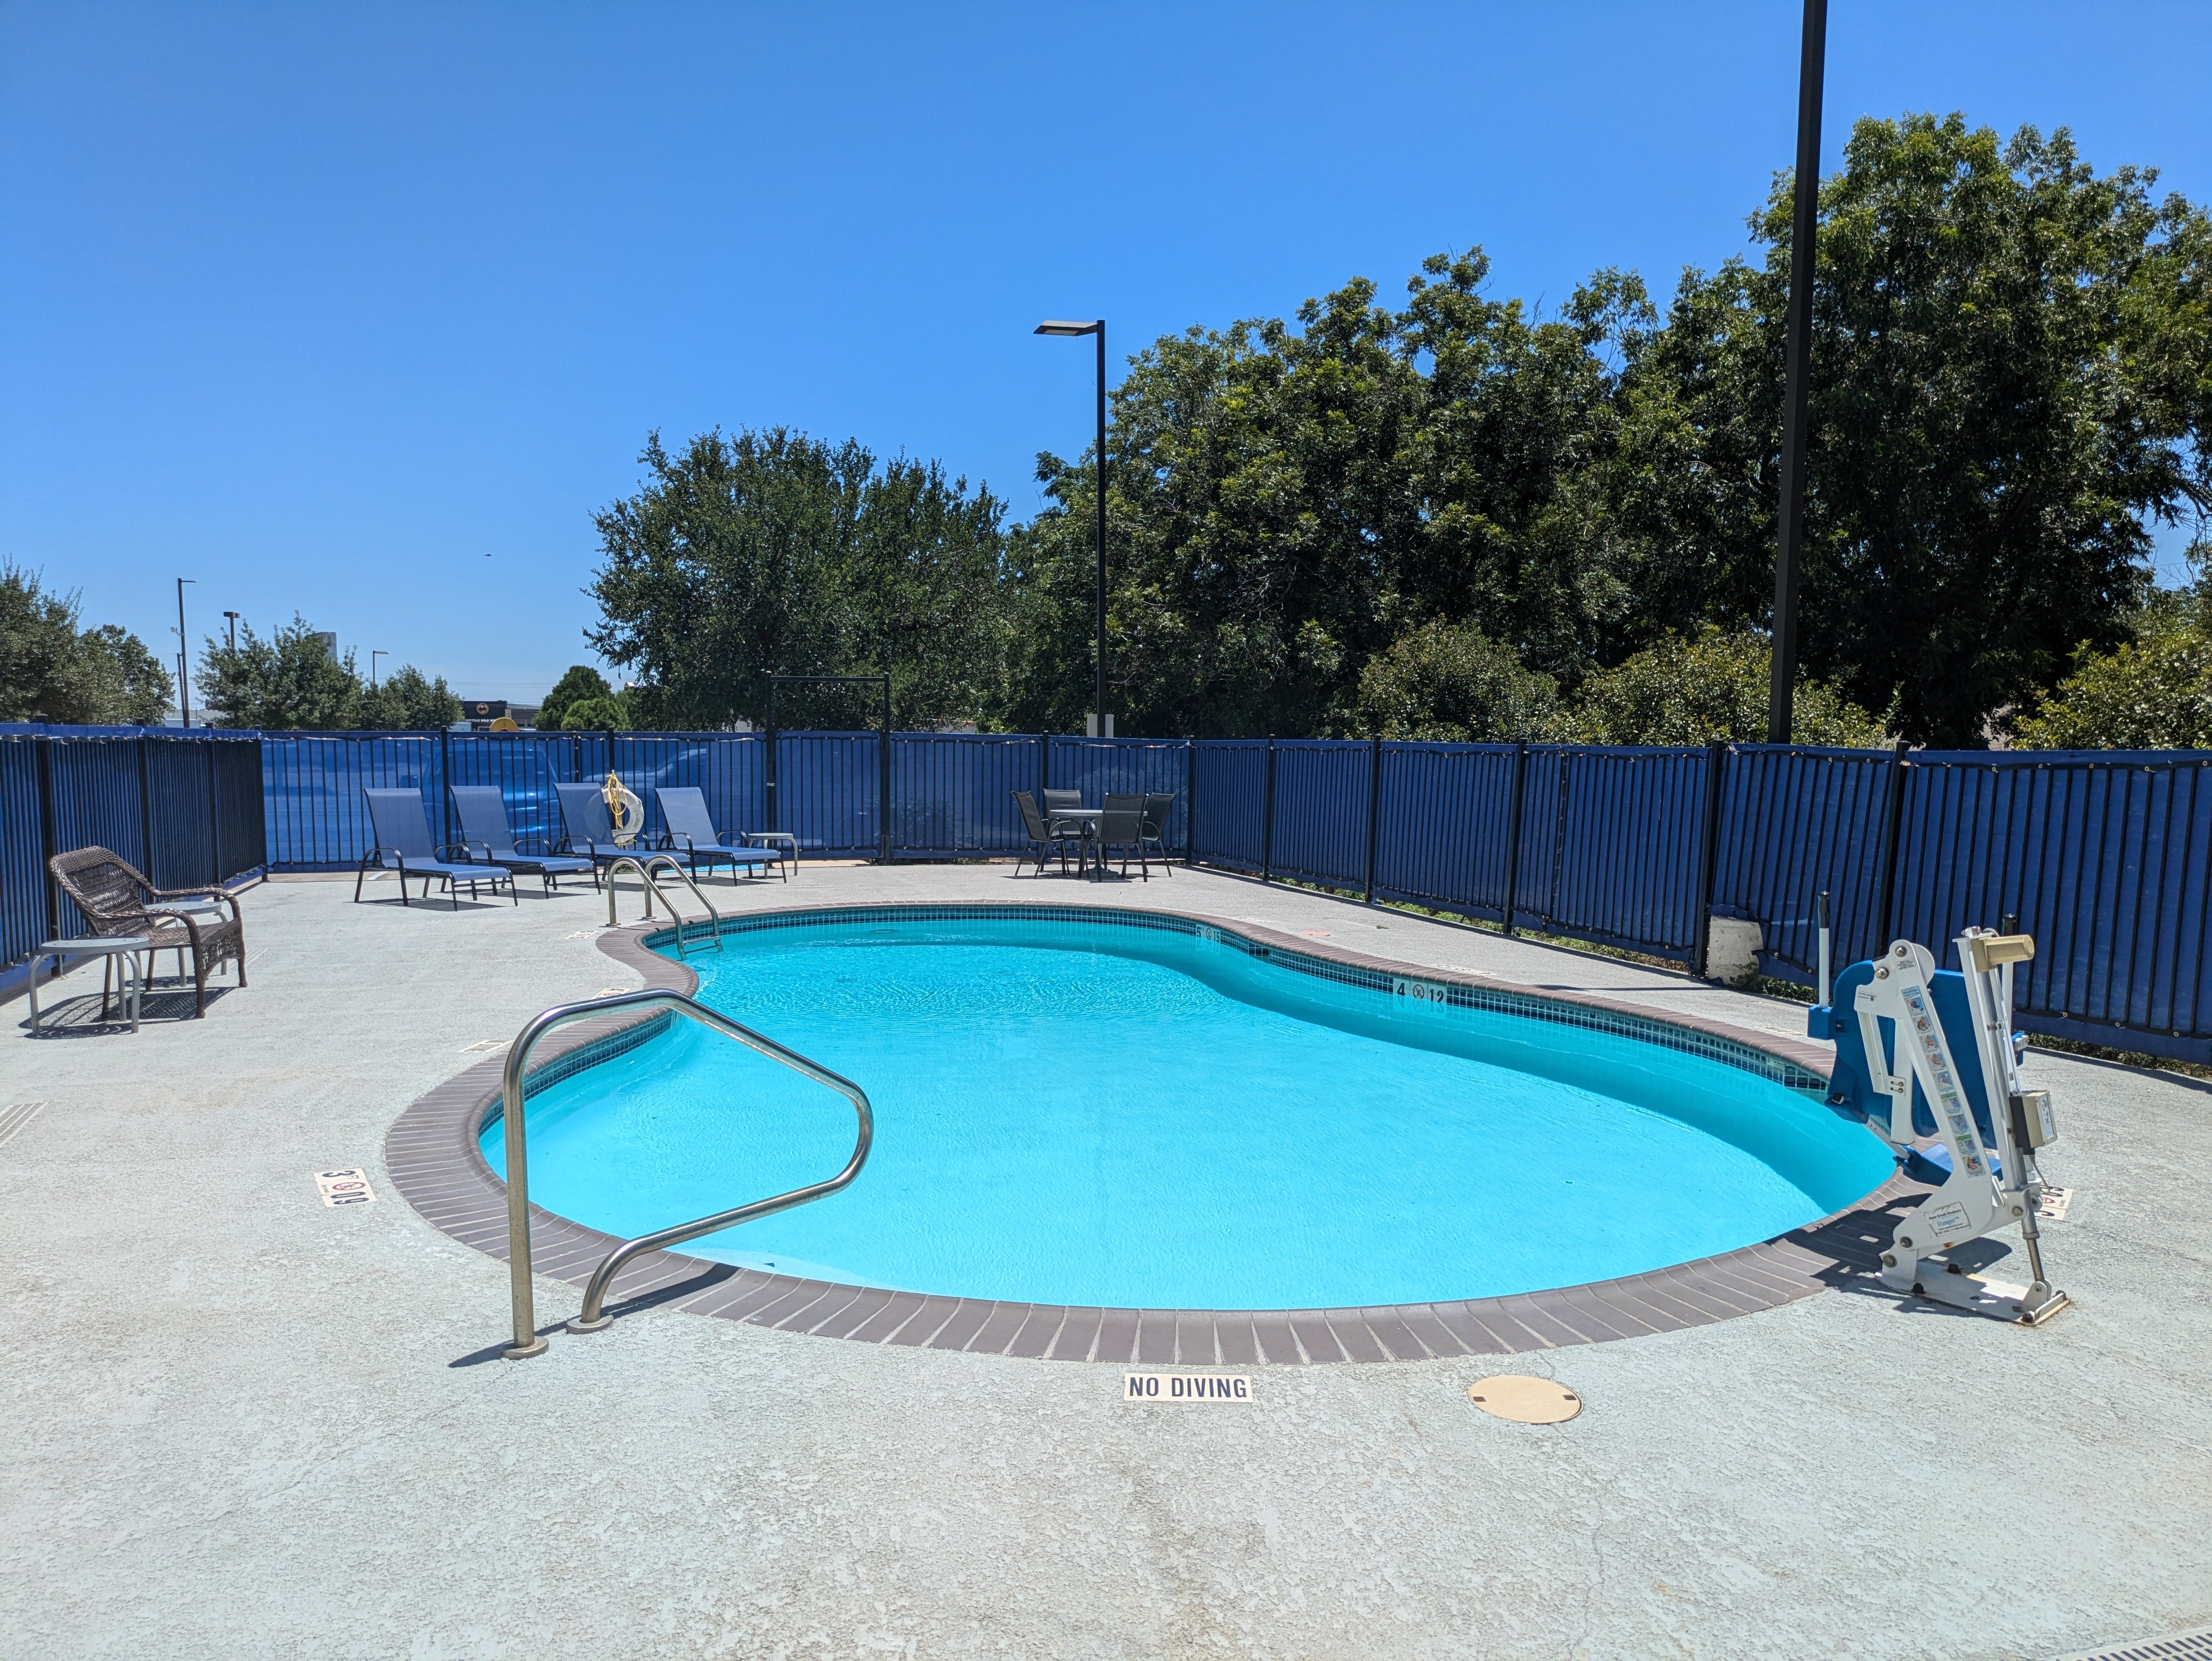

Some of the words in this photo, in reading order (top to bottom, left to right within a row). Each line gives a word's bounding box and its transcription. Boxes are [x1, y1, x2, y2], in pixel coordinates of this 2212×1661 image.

[1397, 982, 1406, 996] 4
[1129, 1376, 1159, 1397] NO
[1171, 1377, 1247, 1398] DIVING
